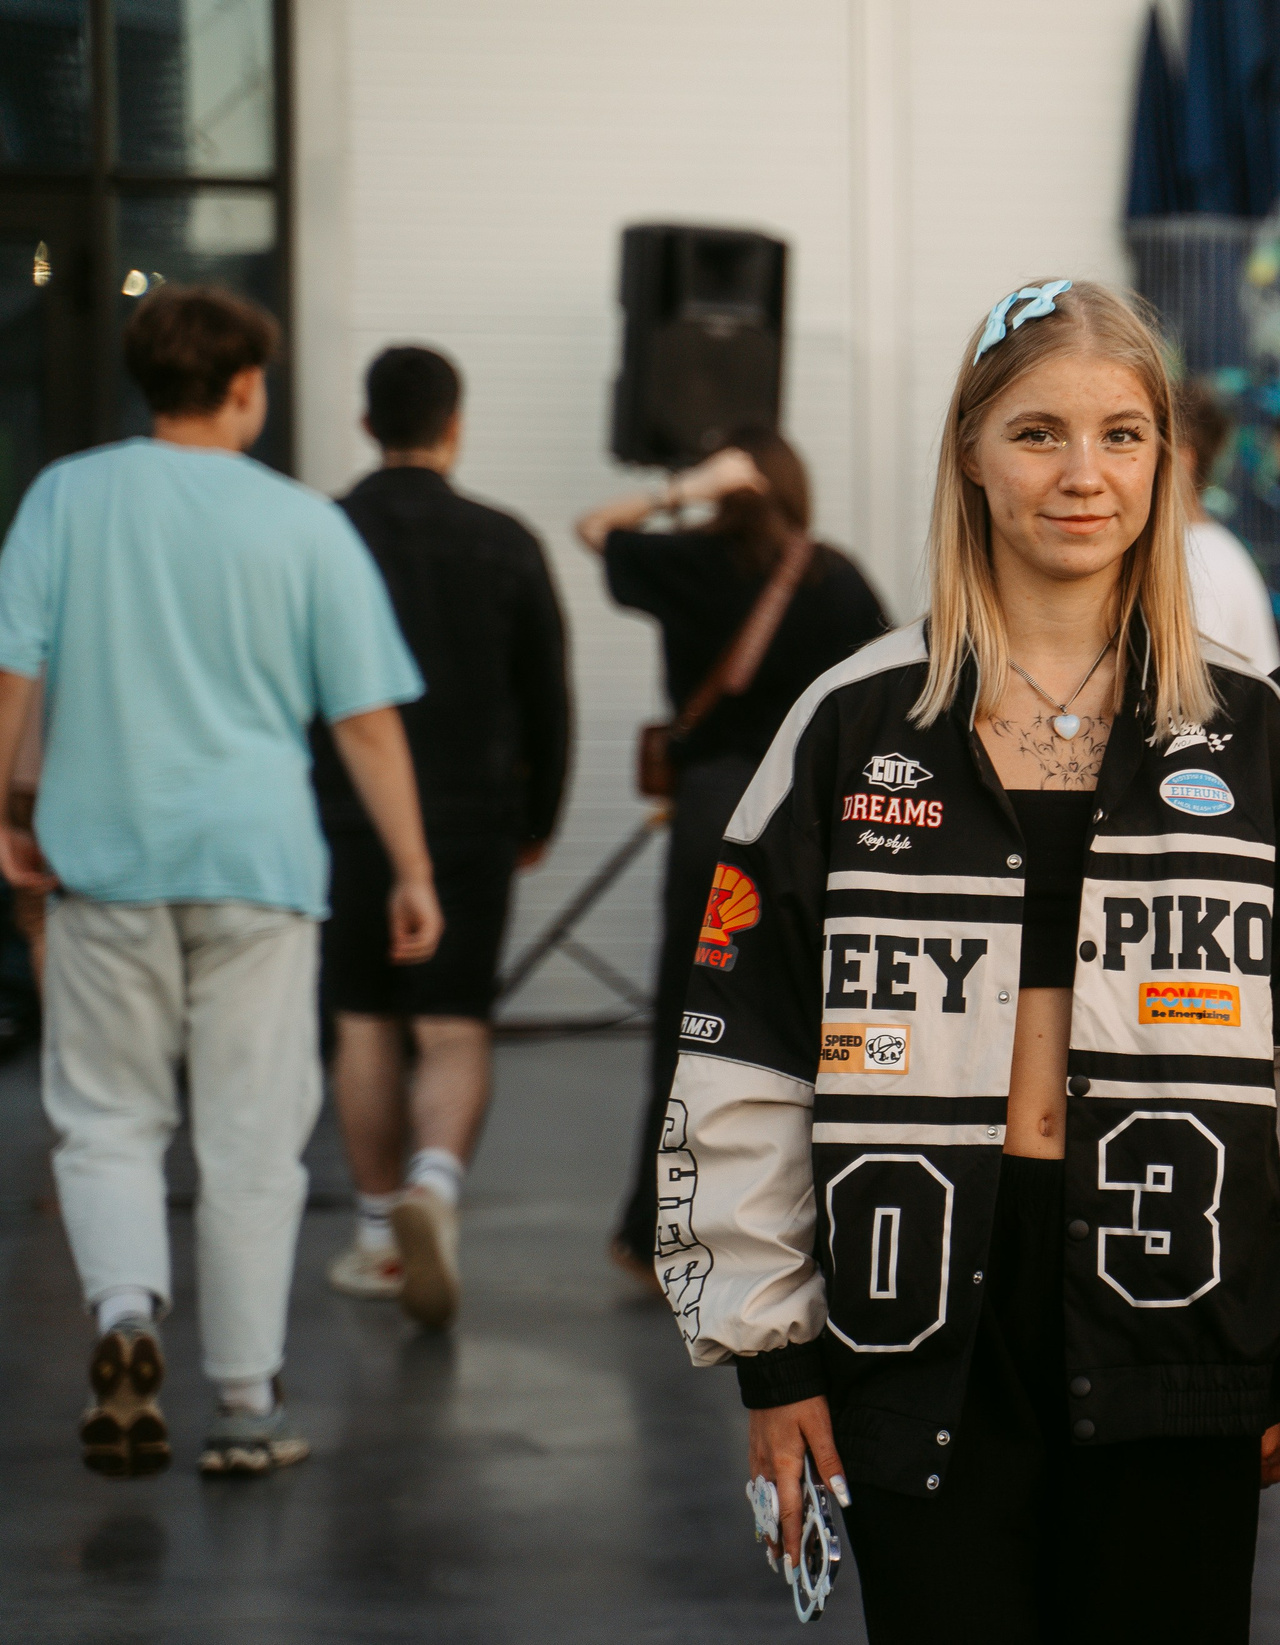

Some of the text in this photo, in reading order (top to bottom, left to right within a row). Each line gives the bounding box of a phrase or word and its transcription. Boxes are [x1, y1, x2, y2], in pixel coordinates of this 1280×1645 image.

[872, 757, 918, 785] CUTE
[841, 793, 944, 828] DREAMS
[857, 829, 912, 855] Keep style
[1102, 895, 1273, 977] PIKO
[824, 934, 988, 1014] EEY
[1146, 987, 1233, 1010] POWER
[1151, 1009, 1231, 1021] Be Energizing
[825, 1034, 863, 1047] SPEED
[1098, 1110, 1226, 1308] 3
